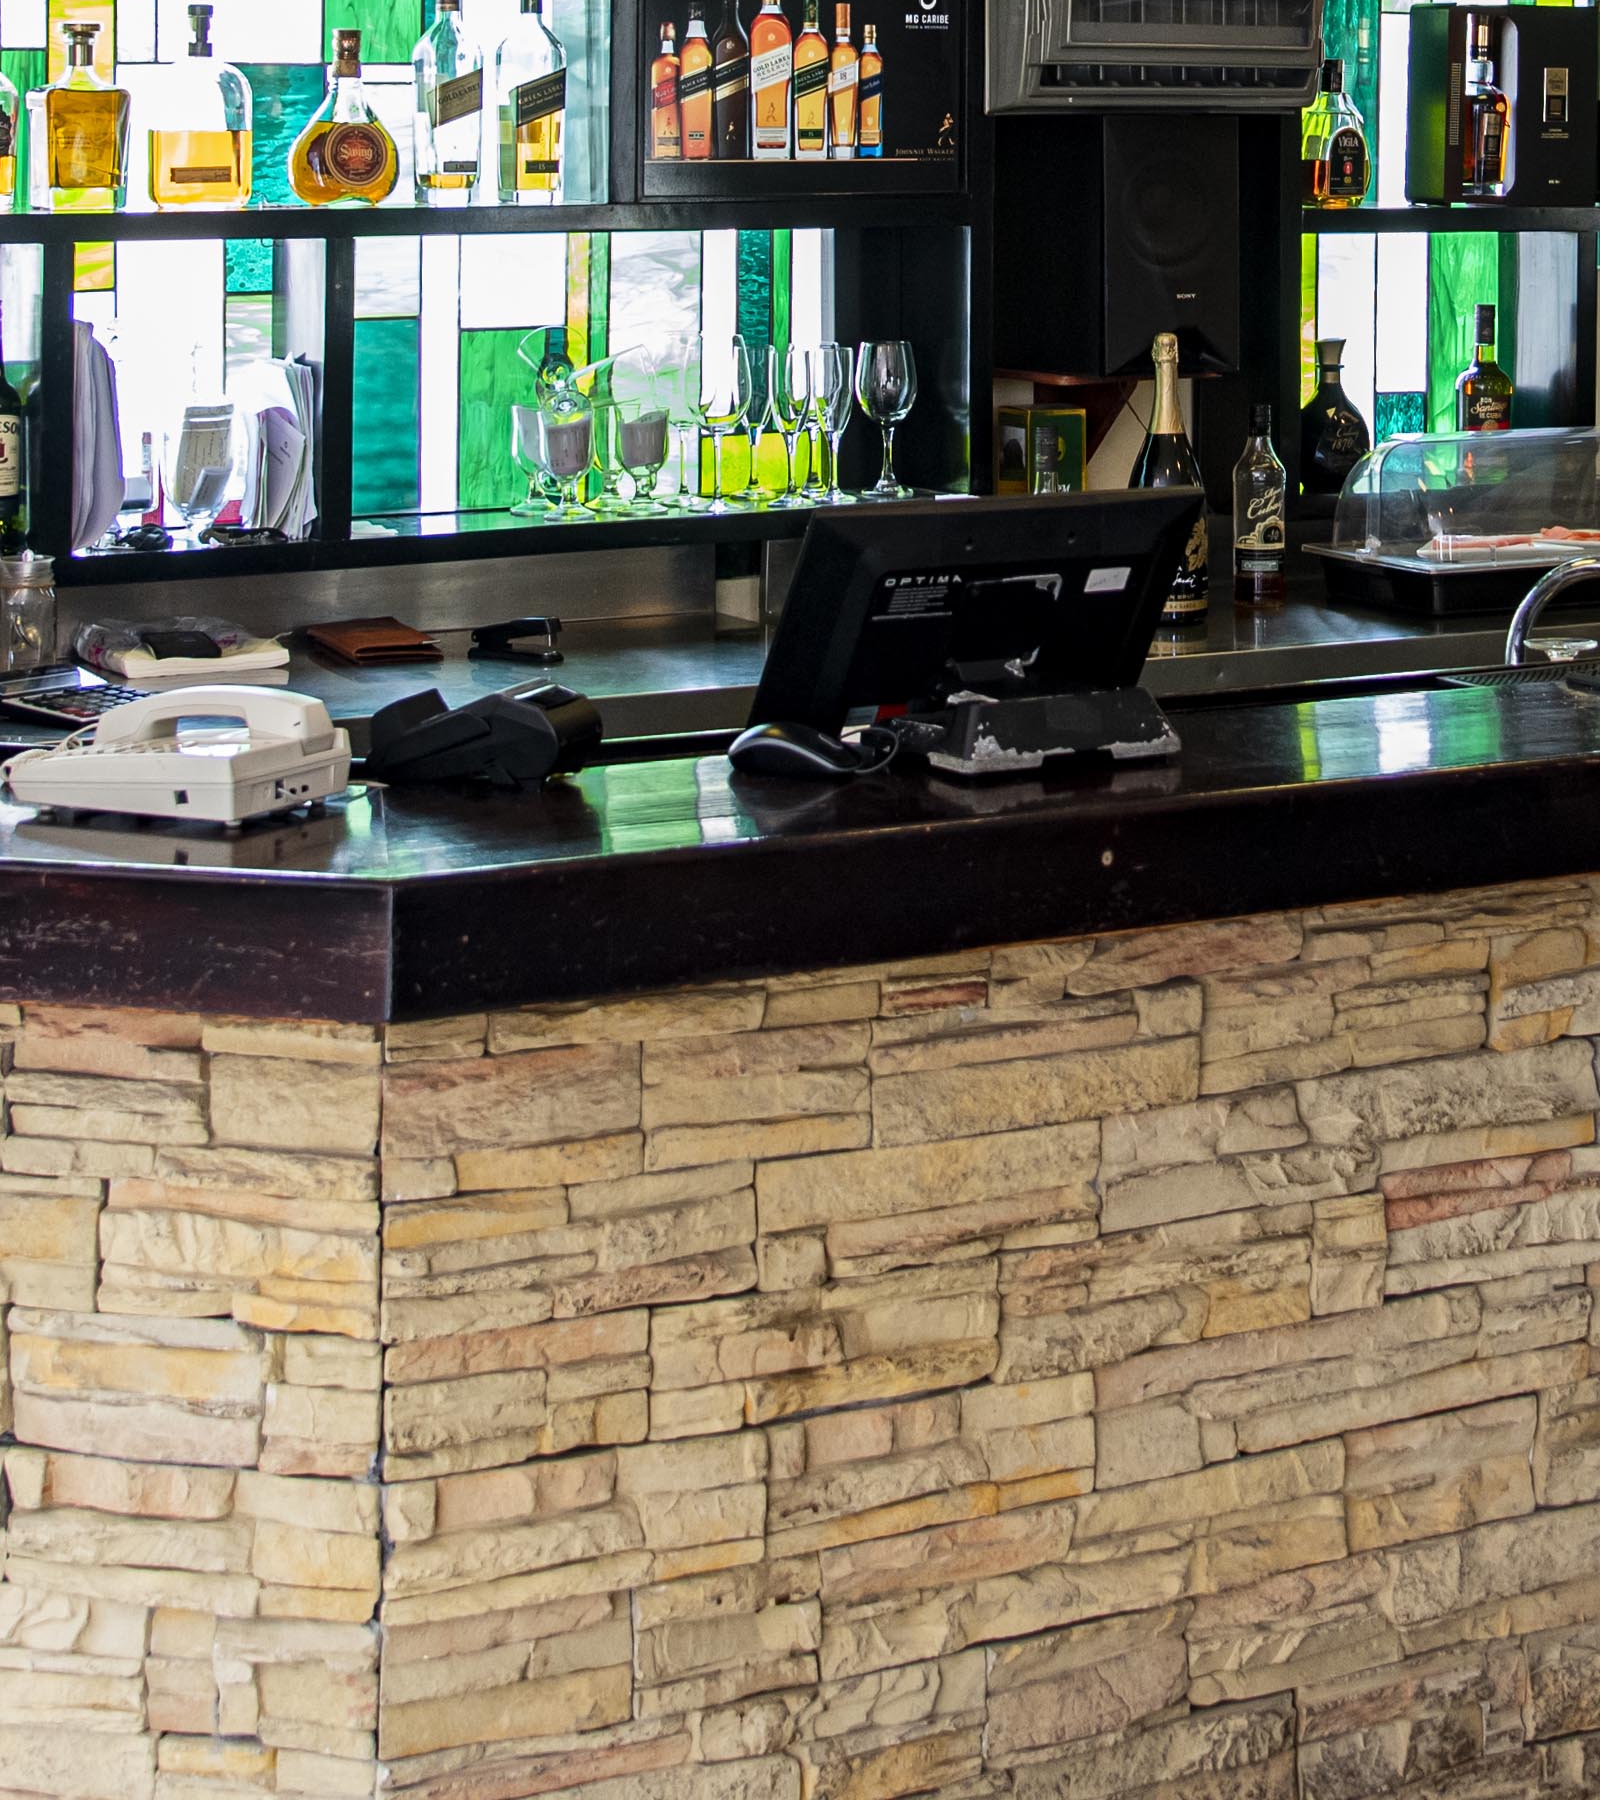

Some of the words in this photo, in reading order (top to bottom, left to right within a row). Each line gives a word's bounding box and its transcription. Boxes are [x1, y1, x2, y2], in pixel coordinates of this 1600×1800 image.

[905, 14, 919, 24] MG
[922, 14, 949, 25] CARIBE
[753, 61, 770, 73] GOLD
[770, 55, 790, 68] LABEL
[756, 61, 791, 77] RESERVE
[437, 92, 458, 106] GOLD
[895, 148, 924, 157] JOHNNIE
[884, 575, 963, 588] OPTIMA
